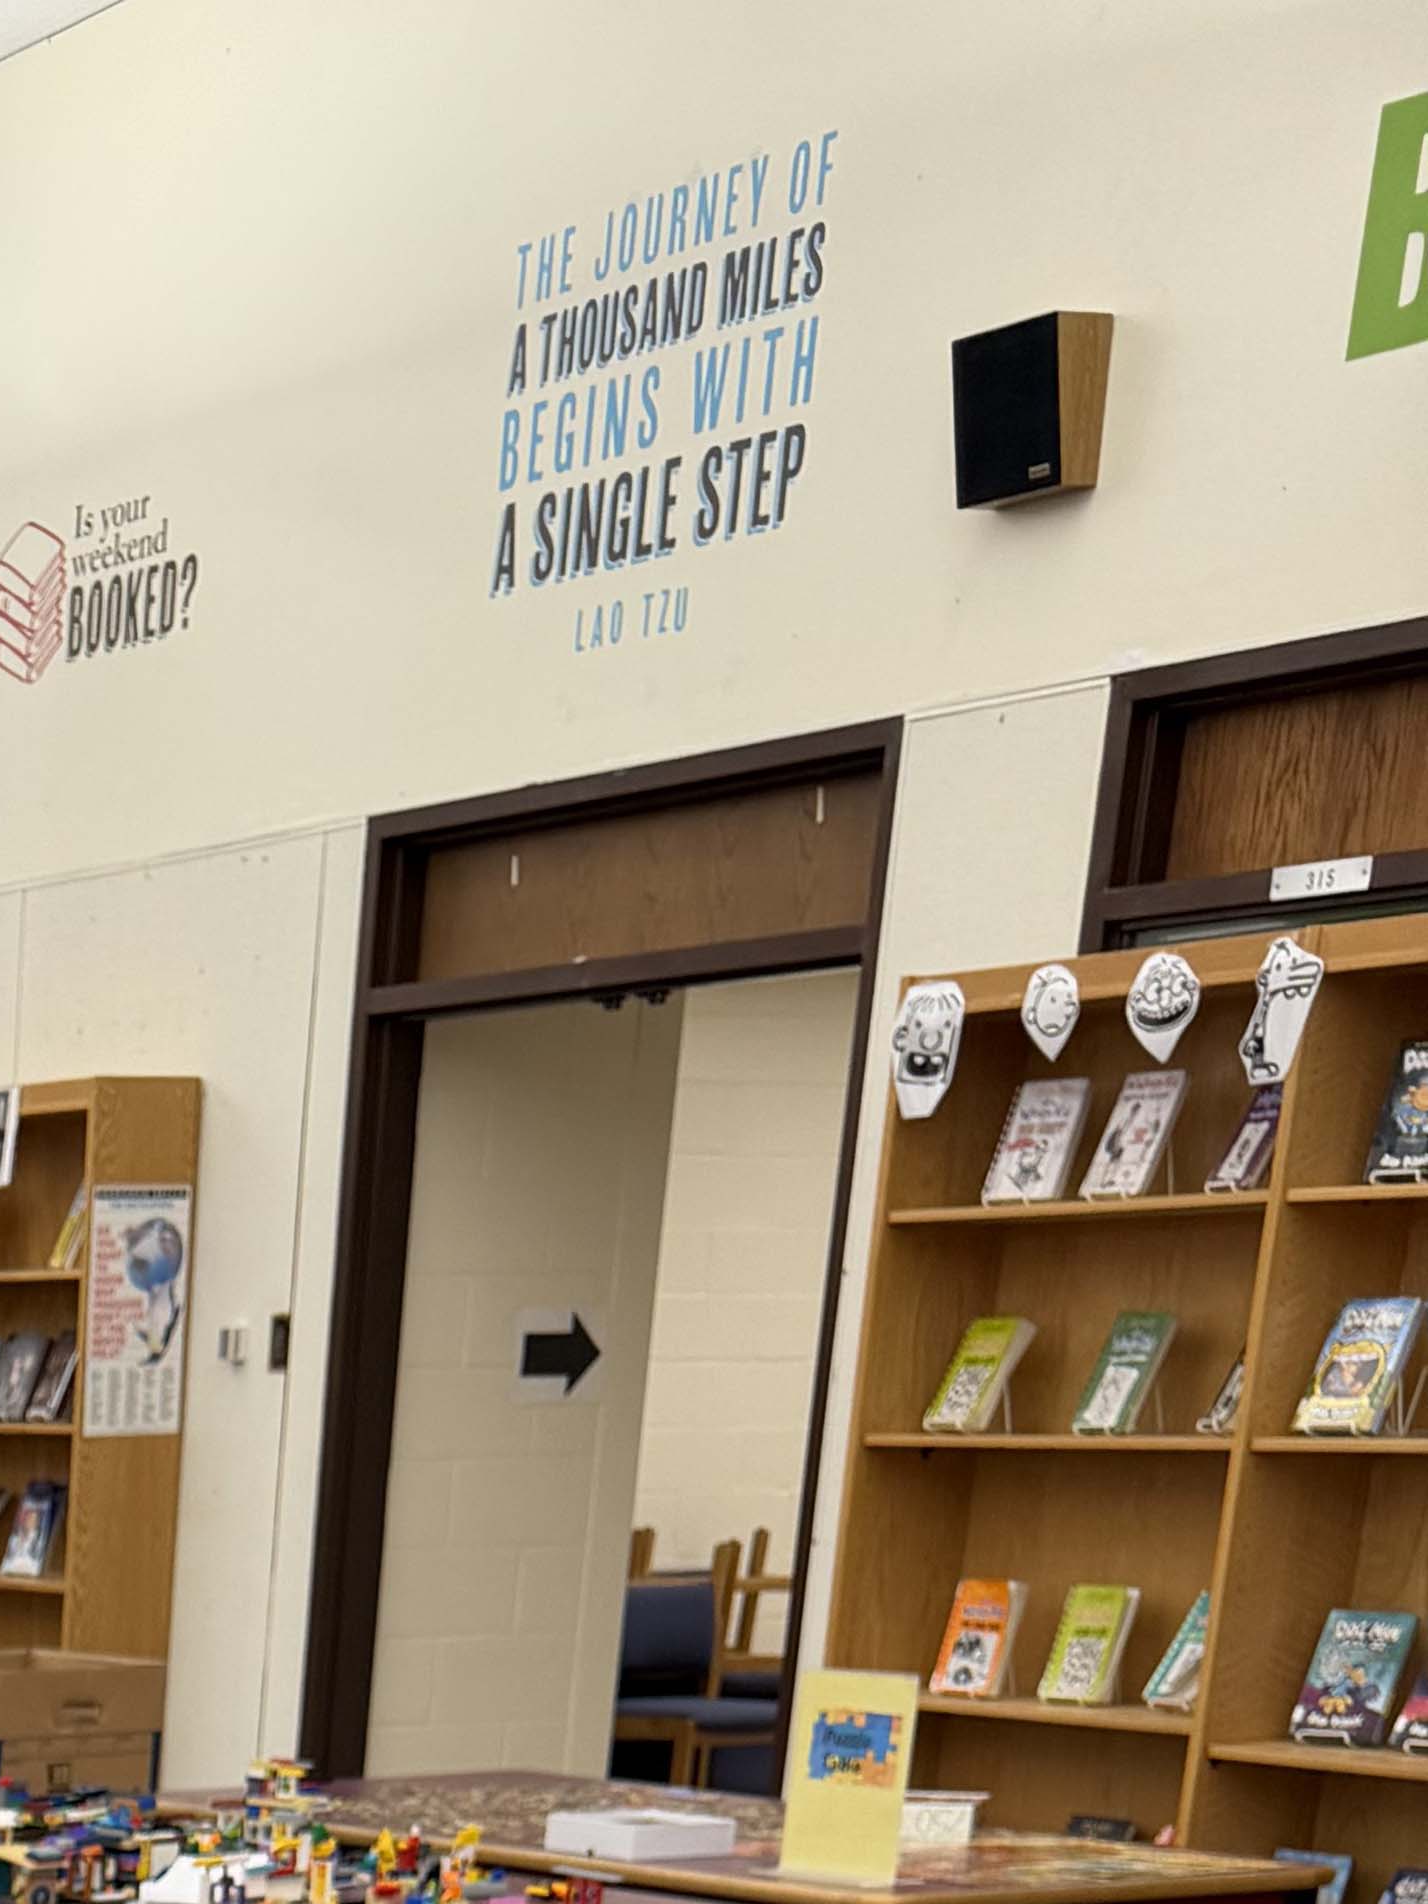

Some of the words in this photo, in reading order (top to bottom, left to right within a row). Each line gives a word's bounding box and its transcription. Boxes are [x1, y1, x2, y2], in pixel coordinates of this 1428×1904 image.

[516, 225, 576, 310] THE
[594, 152, 770, 282] JOURNEY
[787, 129, 839, 215] OF
[507, 322, 527, 398] A
[538, 260, 708, 389] THOUSAND
[716, 221, 827, 330] MILES
[498, 365, 661, 493] BEGINS
[691, 315, 820, 435] WITH
[71, 517, 168, 576] weekend
[75, 504, 94, 539] Is
[100, 496, 150, 543] your
[489, 502, 517, 600] A
[527, 456, 683, 589] SINGLE
[692, 422, 807, 547] STEP
[65, 553, 197, 662] BOOKED?
[572, 599, 624, 653] LAO
[642, 586, 690, 638] TZU
[1305, 868, 1336, 890] 315
